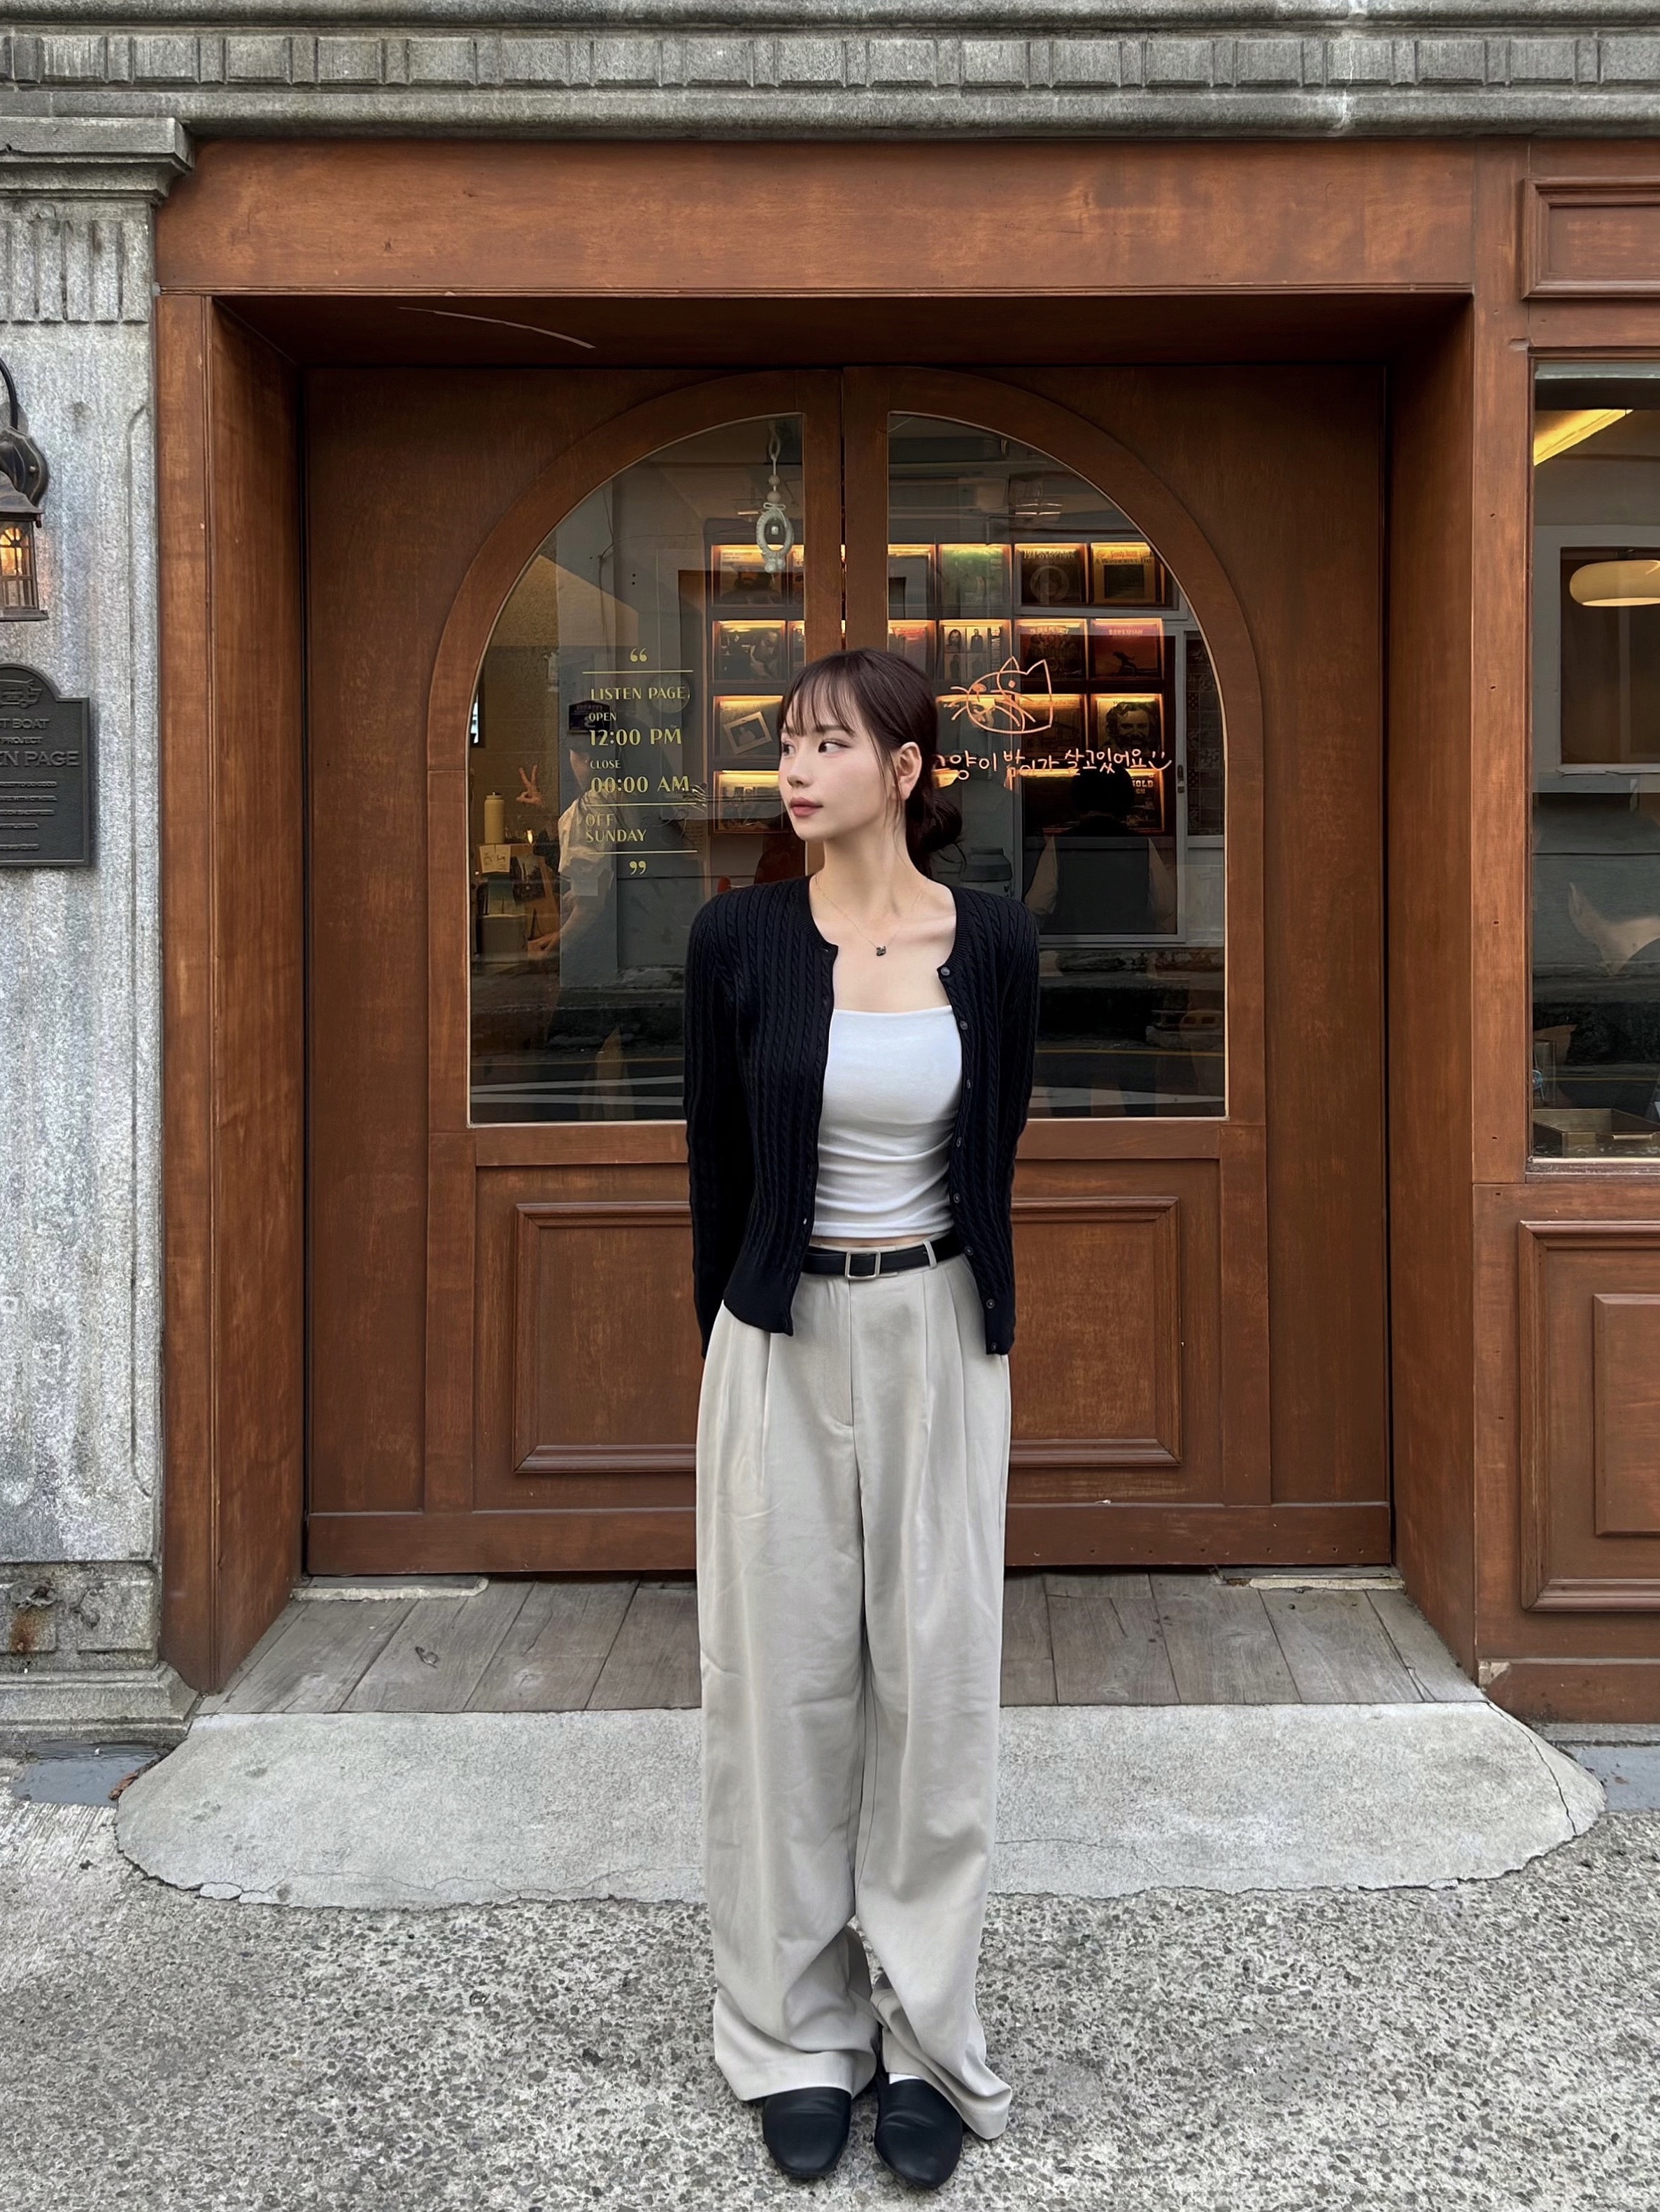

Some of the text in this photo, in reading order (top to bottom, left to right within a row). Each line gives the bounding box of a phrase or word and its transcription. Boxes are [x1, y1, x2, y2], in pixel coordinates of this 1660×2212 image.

[590, 686, 686, 701] LISTEN PAGE
[13, 718, 50, 729] BOAT
[588, 712, 617, 722] OPEN
[589, 727, 682, 746] 12:00 PM
[24, 750, 80, 767] PAGE
[590, 759, 621, 769] CLOSE
[590, 776, 690, 794] 00:00 AM
[586, 813, 616, 827] OFF
[586, 829, 647, 843] SUNDAY
